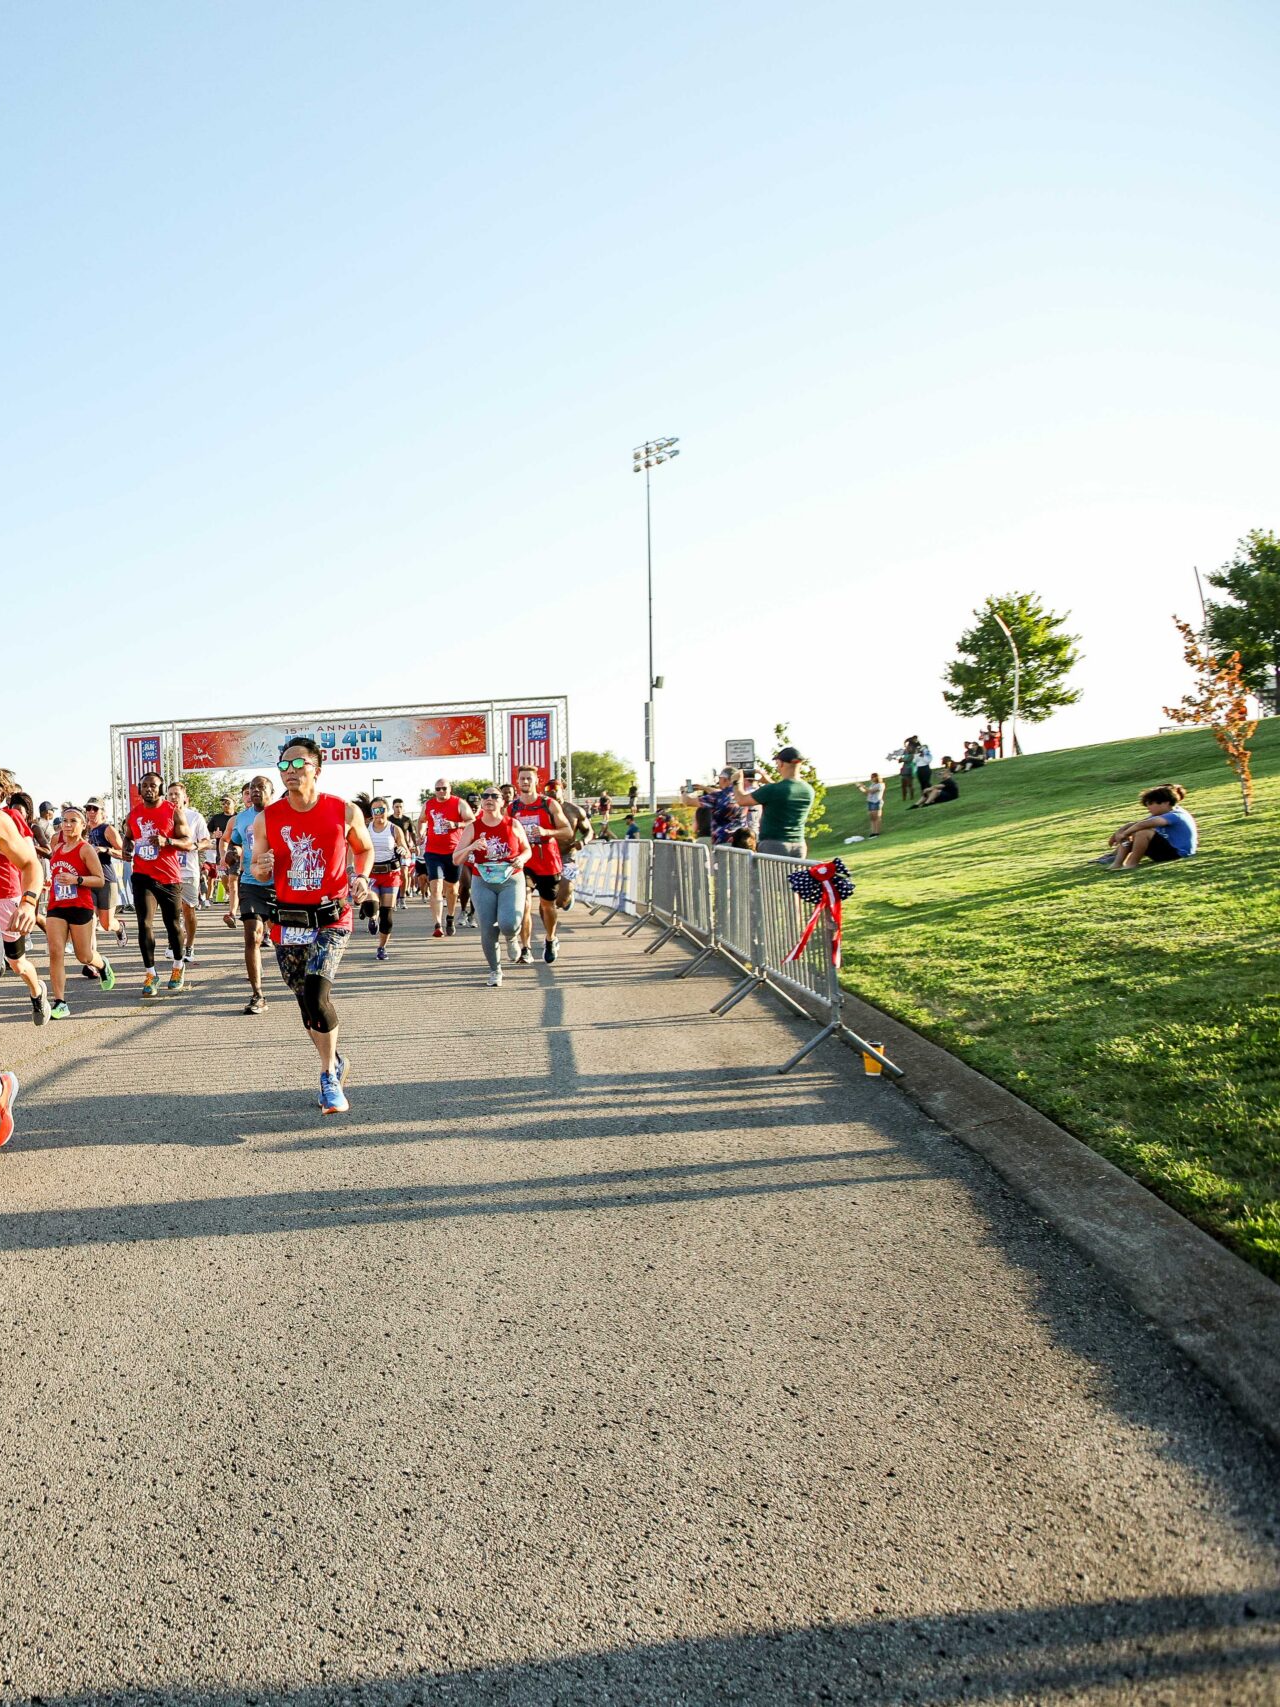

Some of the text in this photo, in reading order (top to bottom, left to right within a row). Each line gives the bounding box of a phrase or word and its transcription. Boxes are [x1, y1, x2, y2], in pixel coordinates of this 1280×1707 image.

[284, 722, 377, 735] 15TH ANNUAL
[341, 729, 382, 747] 4TH
[361, 746, 378, 761] 5K
